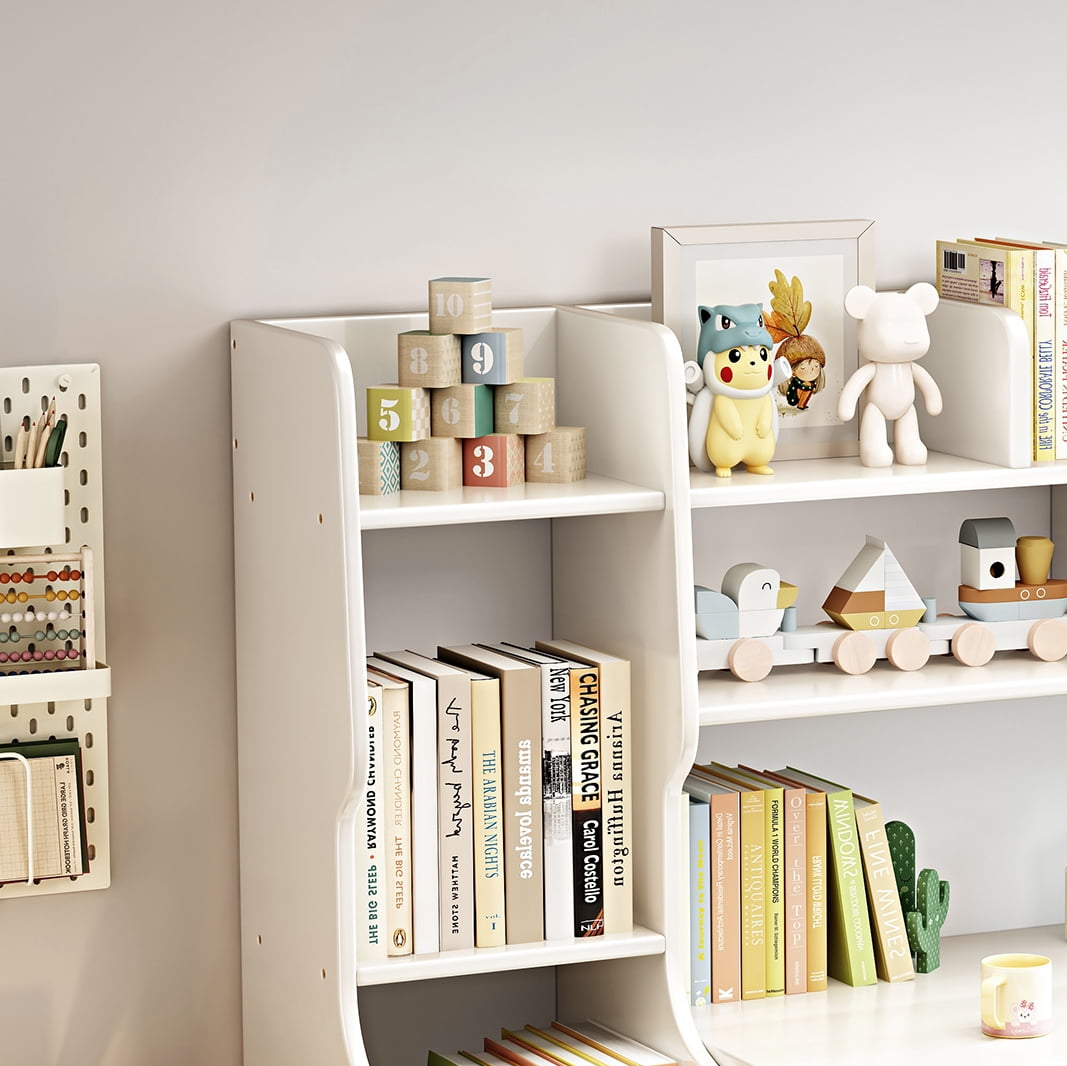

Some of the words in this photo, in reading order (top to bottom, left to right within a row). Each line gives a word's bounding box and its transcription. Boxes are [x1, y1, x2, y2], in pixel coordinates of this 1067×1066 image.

[435, 293, 464, 317] 10
[409, 347, 429, 375] 8
[470, 342, 494, 375] 9
[378, 398, 400, 431] 5
[441, 398, 461, 425] 6
[504, 392, 524, 424] 7
[409, 449, 430, 481] 2
[472, 445, 494, 478] 3
[533, 442, 555, 473] 4
[550, 668, 568, 692] New
[550, 696, 570, 723] York
[579, 673, 598, 745] CHASING
[482, 750, 496, 775] THE
[581, 749, 600, 802] GRACE
[483, 778, 498, 830] ARABIAN
[771, 799, 779, 832] FORMULA
[583, 819, 599, 852] Carol
[484, 834, 500, 879] NIGHTS
[583, 854, 600, 903] Costello
[749, 843, 763, 946] ANTIQUAIRES
